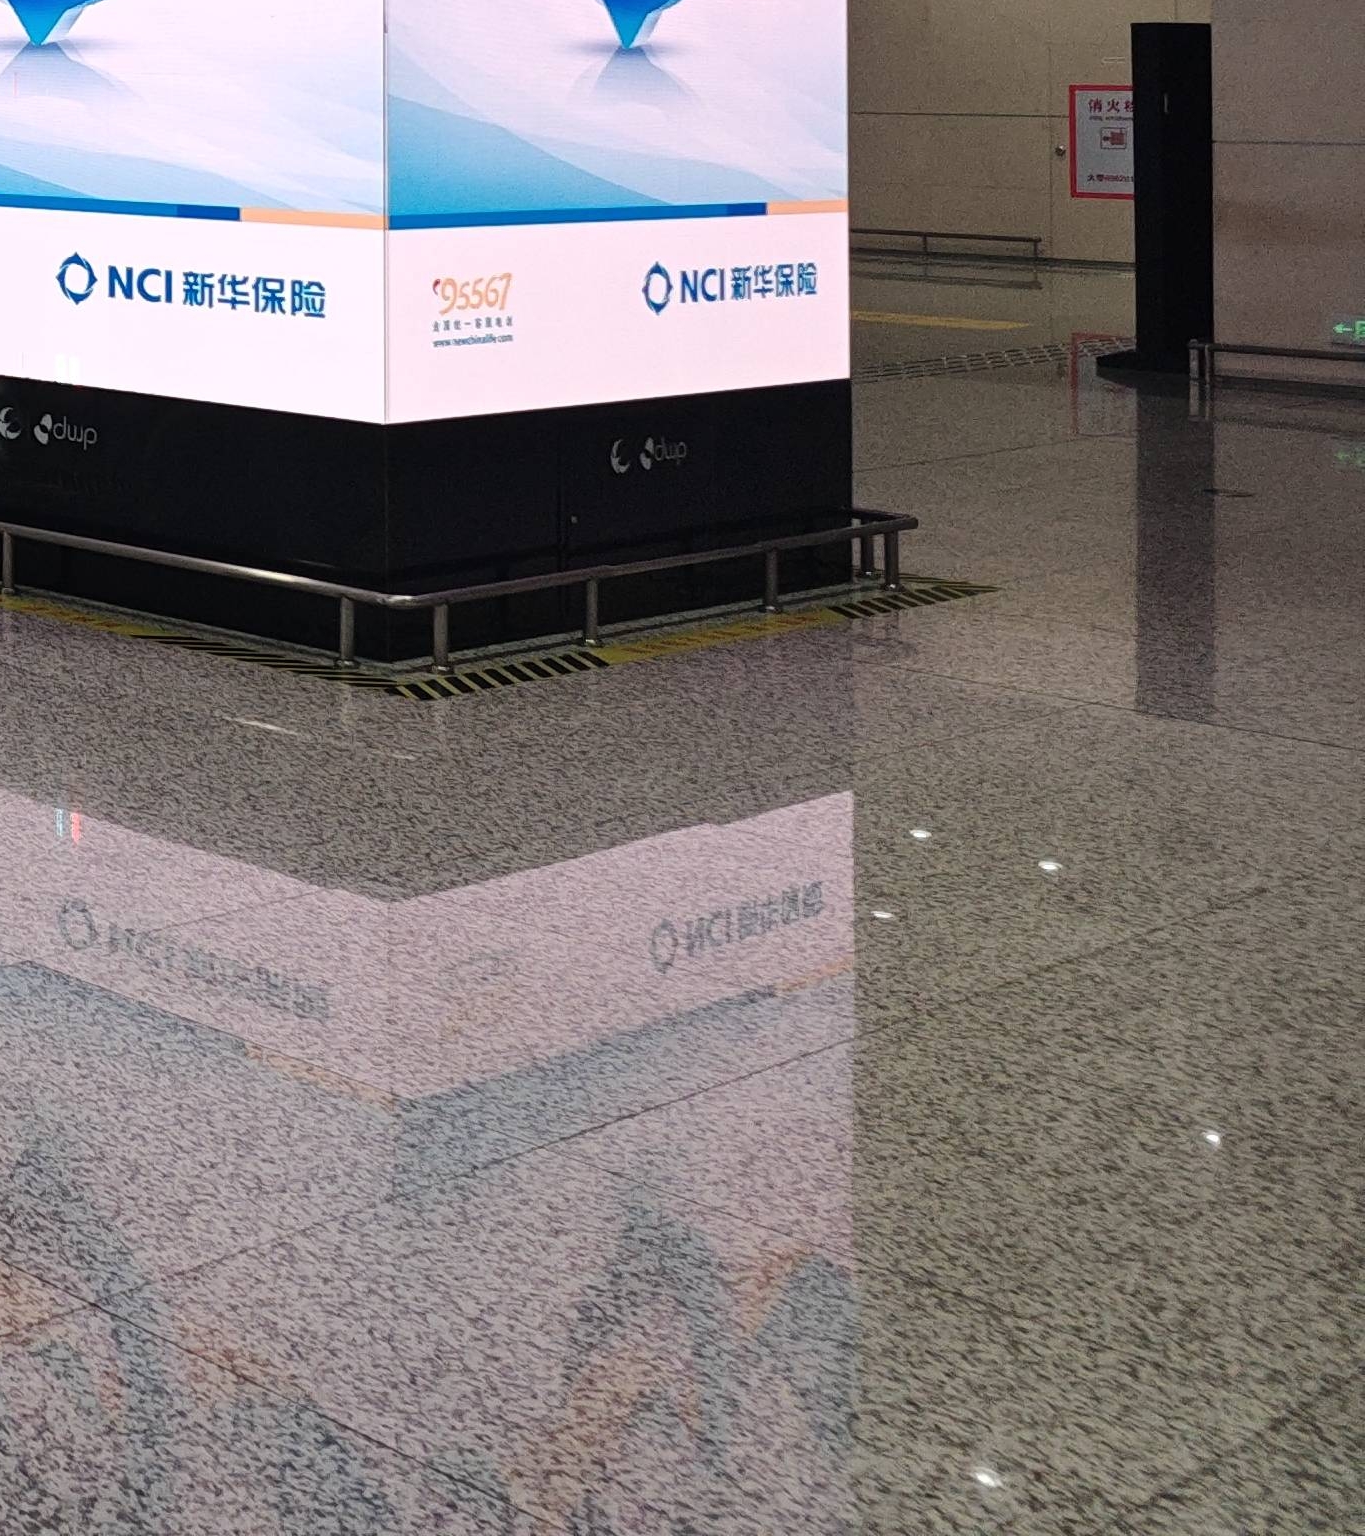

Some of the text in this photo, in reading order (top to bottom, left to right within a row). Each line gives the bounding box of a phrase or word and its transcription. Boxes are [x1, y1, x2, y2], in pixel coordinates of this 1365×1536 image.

[107, 265, 326, 319] NCI 新华保险
[438, 272, 513, 316] 95567
[680, 262, 818, 304] NCI 新华保险
